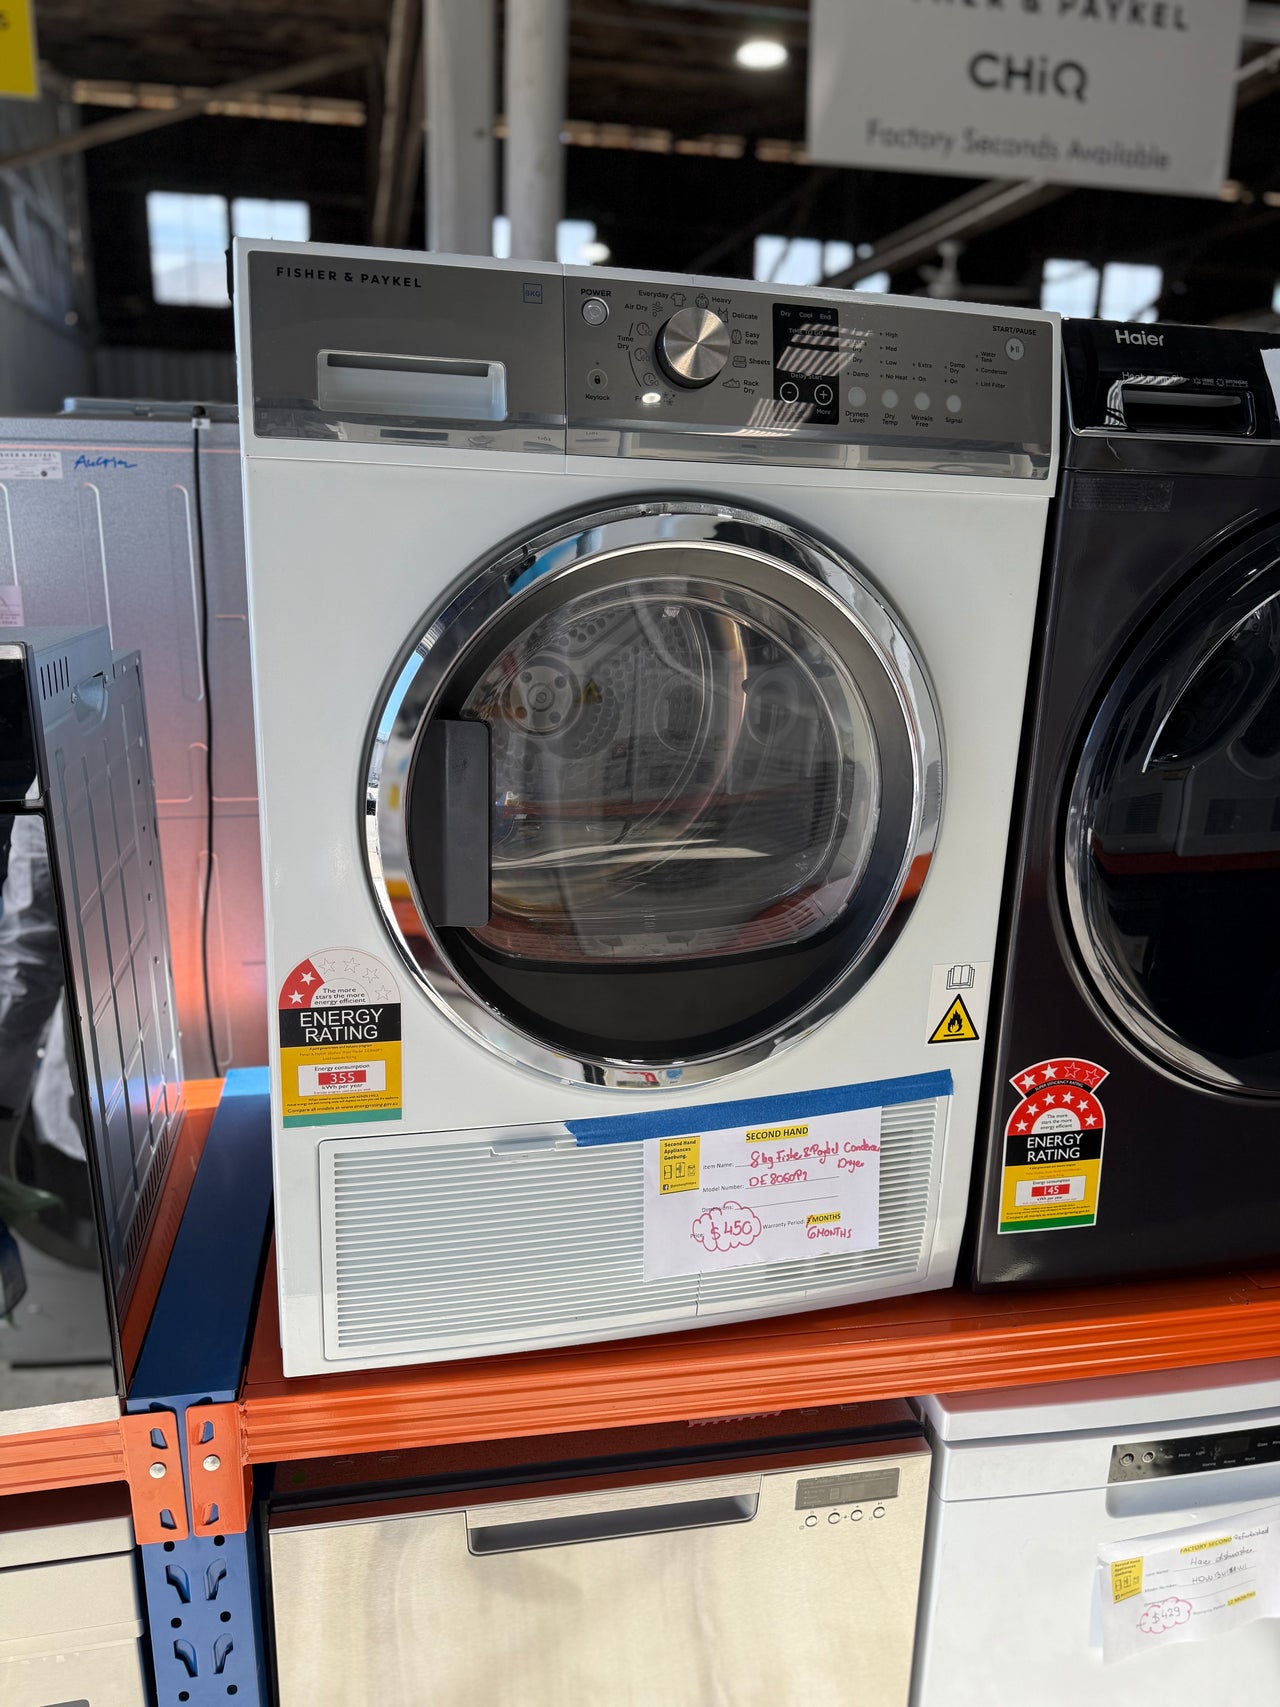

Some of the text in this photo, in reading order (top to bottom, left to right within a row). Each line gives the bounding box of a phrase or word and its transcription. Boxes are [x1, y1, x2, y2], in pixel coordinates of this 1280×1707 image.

[1056, 0, 1189, 31] PAYKEL
[967, 51, 1089, 103] CHiQ
[866, 117, 1171, 171] Factory Seconds Available
[276, 266, 422, 288] FISHER & PAYKEL
[580, 288, 612, 297] POWER
[638, 289, 669, 299] Everyday
[711, 296, 732, 305] Heavy
[624, 303, 648, 312] Air Dry
[732, 312, 758, 320] Delicate
[799, 311, 813, 319] Cool
[885, 331, 898, 339] High
[992, 325, 1037, 336] START/PAUSE
[617, 335, 634, 343] Time
[745, 331, 760, 341] Easy
[1114, 329, 1165, 347] Haier
[617, 343, 630, 351] Dry
[748, 358, 771, 366] Sheets
[949, 362, 966, 370] Damp
[852, 370, 870, 378] Damp
[743, 379, 760, 387] Rack
[743, 387, 755, 395] Dry
[585, 393, 610, 401] Keylock
[845, 410, 869, 418] Dryness
[884, 412, 896, 420] Dry
[911, 414, 934, 422] Wrinkle
[945, 416, 963, 424] Signal
[300, 1008, 384, 1027] ENERGY
[305, 1025, 378, 1043] RATING
[334, 1063, 370, 1071] consumption
[330, 1072, 355, 1084] 355
[745, 1126, 809, 1141] SECOND HAND
[1027, 1132, 1084, 1149] ENERGY
[663, 1147, 692, 1155] Appliances
[1027, 1147, 1081, 1163] RATING
[717, 1161, 735, 1169] Name:
[837, 1157, 865, 1174] Dryer
[702, 1185, 720, 1193] Model
[720, 1183, 745, 1191] Number:
[1043, 1185, 1060, 1196] 145
[812, 1212, 841, 1223] MONTHS
[762, 1218, 806, 1230] Warranty Period:
[1180, 1542, 1208, 1554] FACTORY
[1208, 1536, 1232, 1548] SECOND
